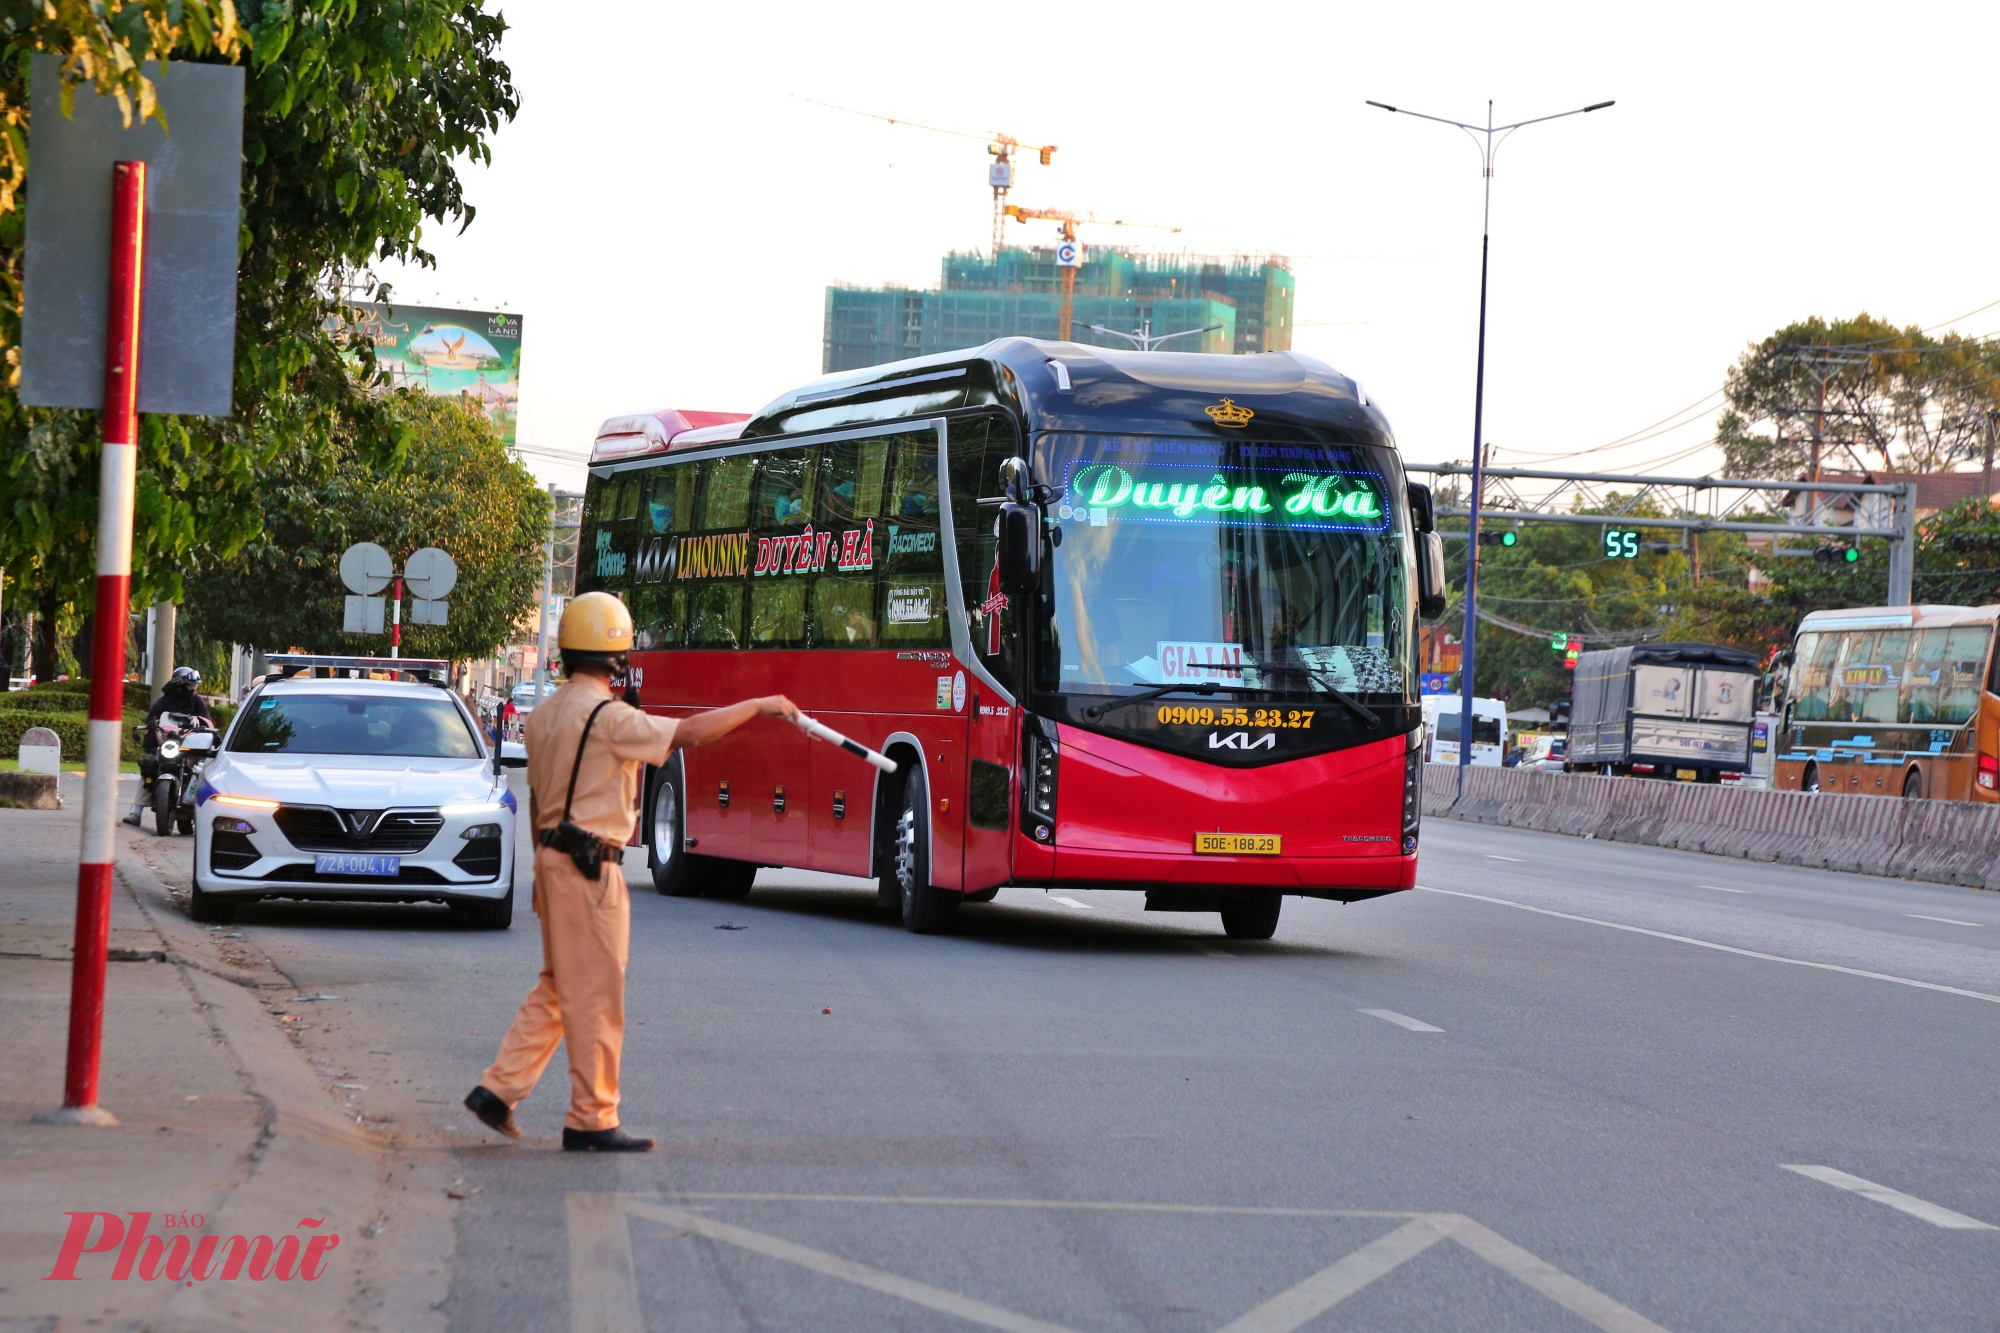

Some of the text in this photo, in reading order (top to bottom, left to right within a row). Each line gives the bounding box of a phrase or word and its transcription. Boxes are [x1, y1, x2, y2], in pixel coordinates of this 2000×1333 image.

[488, 327, 518, 335] LAND
[1134, 441, 1152, 454] XE
[1073, 464, 1382, 518] Duyên Hà
[596, 529, 612, 550] New
[754, 523, 831, 576] DUYÊN
[887, 525, 936, 562] TRACOMECO
[1606, 531, 1638, 558] 55
[596, 549, 627, 582] Home
[677, 529, 750, 582] LIMOUSINE
[1162, 645, 1242, 679] GIA LAI
[1846, 670, 1867, 684] KIM
[1158, 706, 1315, 729] 0909.55.23.27
[1203, 837, 1274, 850] 50E-188.29
[319, 856, 396, 874] 72A-004.14
